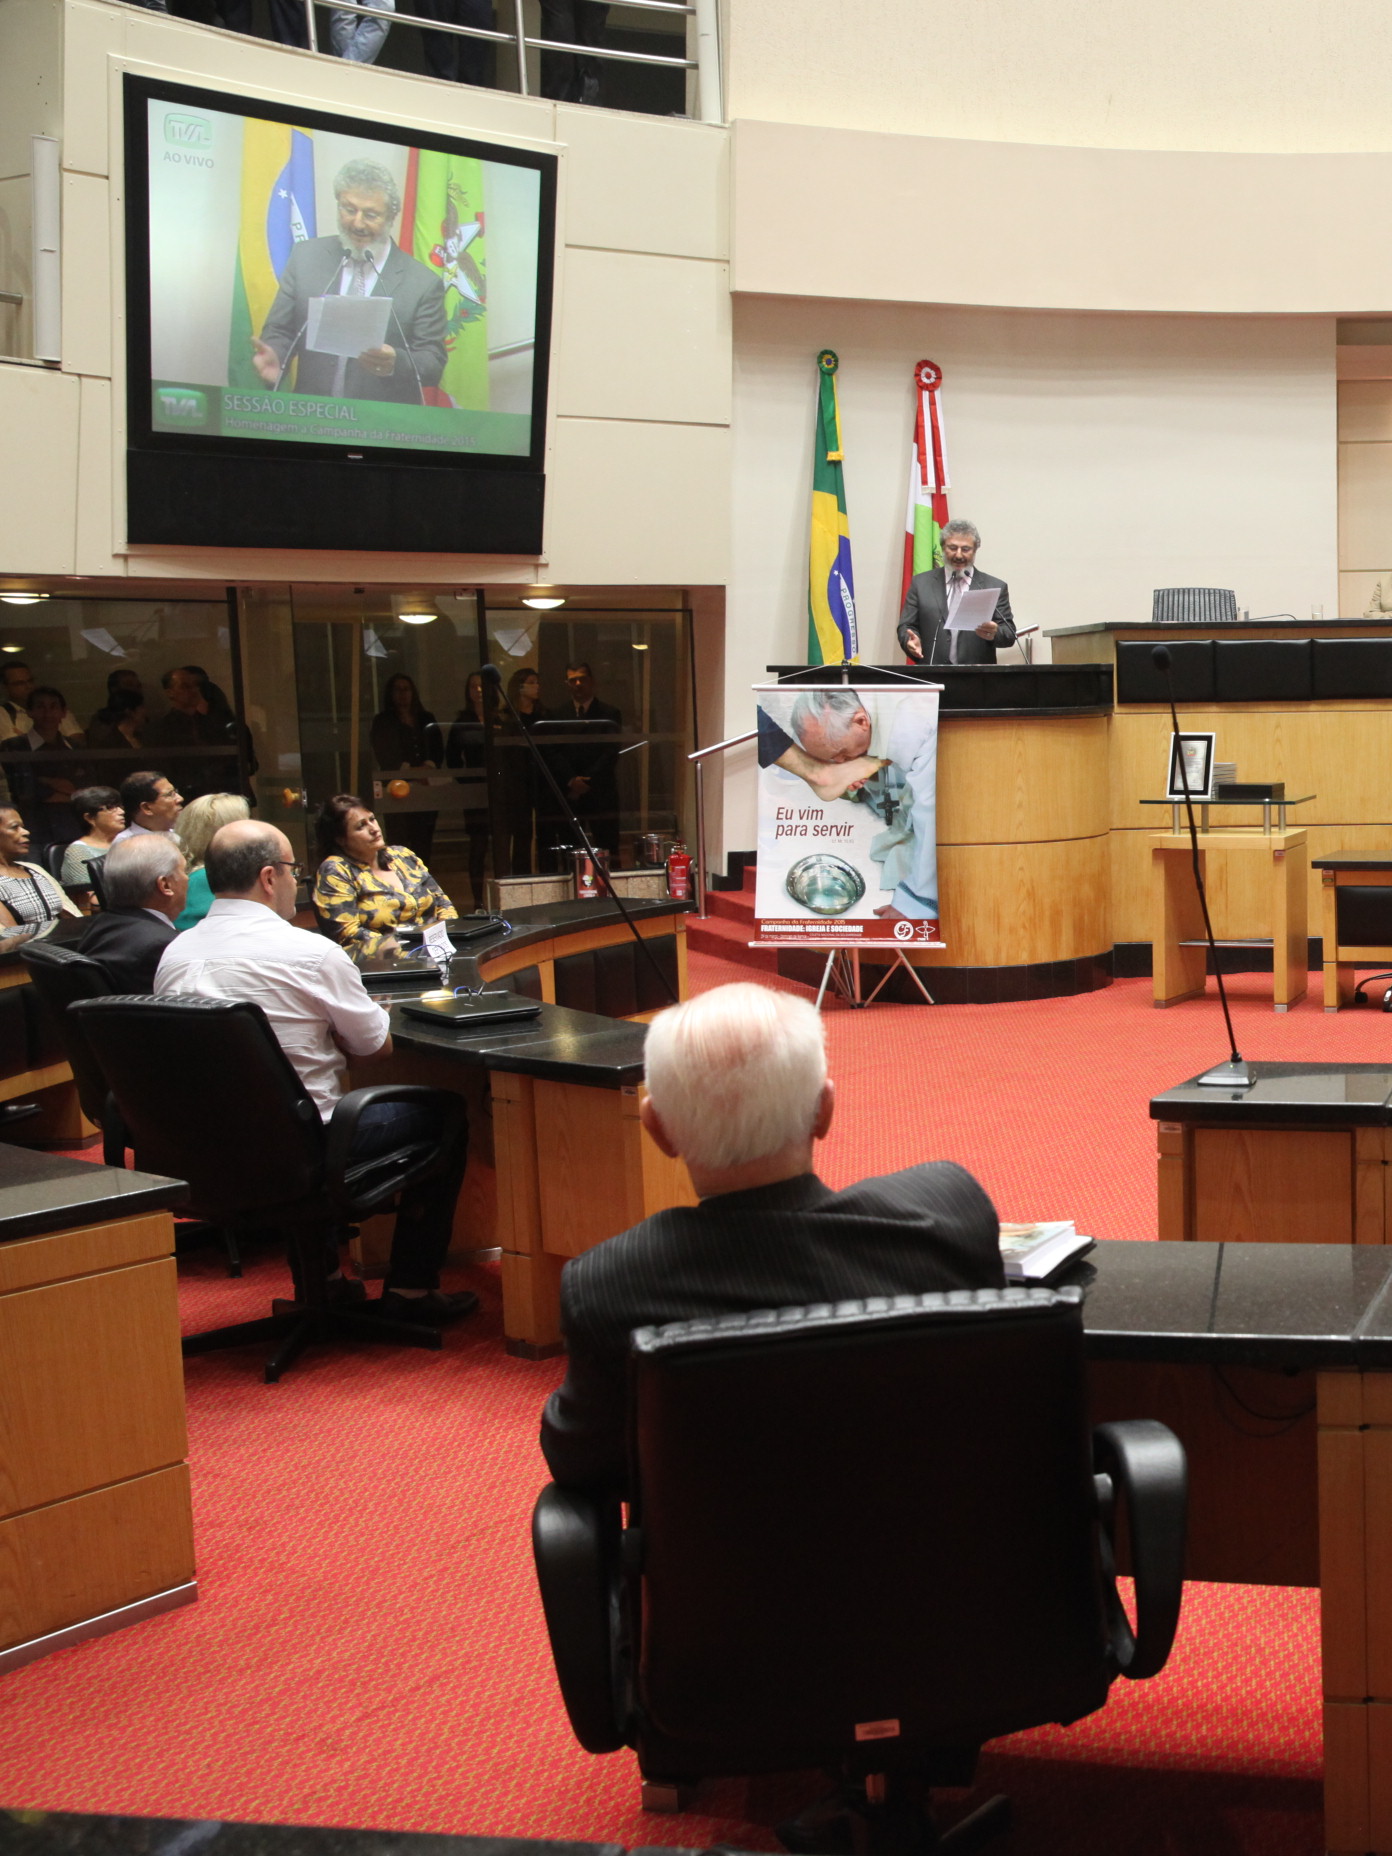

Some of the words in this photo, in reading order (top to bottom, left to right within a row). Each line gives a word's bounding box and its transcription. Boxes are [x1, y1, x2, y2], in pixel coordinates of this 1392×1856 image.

[163, 151, 182, 163] AO
[184, 154, 215, 168] VIVO
[224, 394, 285, 415] SESSÃO
[289, 400, 358, 421] ESPECIAL
[225, 416, 298, 433] Homenagem
[310, 423, 367, 438] Campanha
[370, 429, 383, 440] da
[385, 430, 449, 446] Fraternidade
[841, 588, 856, 653] PROGRESSO
[776, 807, 794, 820] Eu
[798, 806, 824, 820] vim
[775, 824, 808, 840] para
[812, 821, 855, 837] servir
